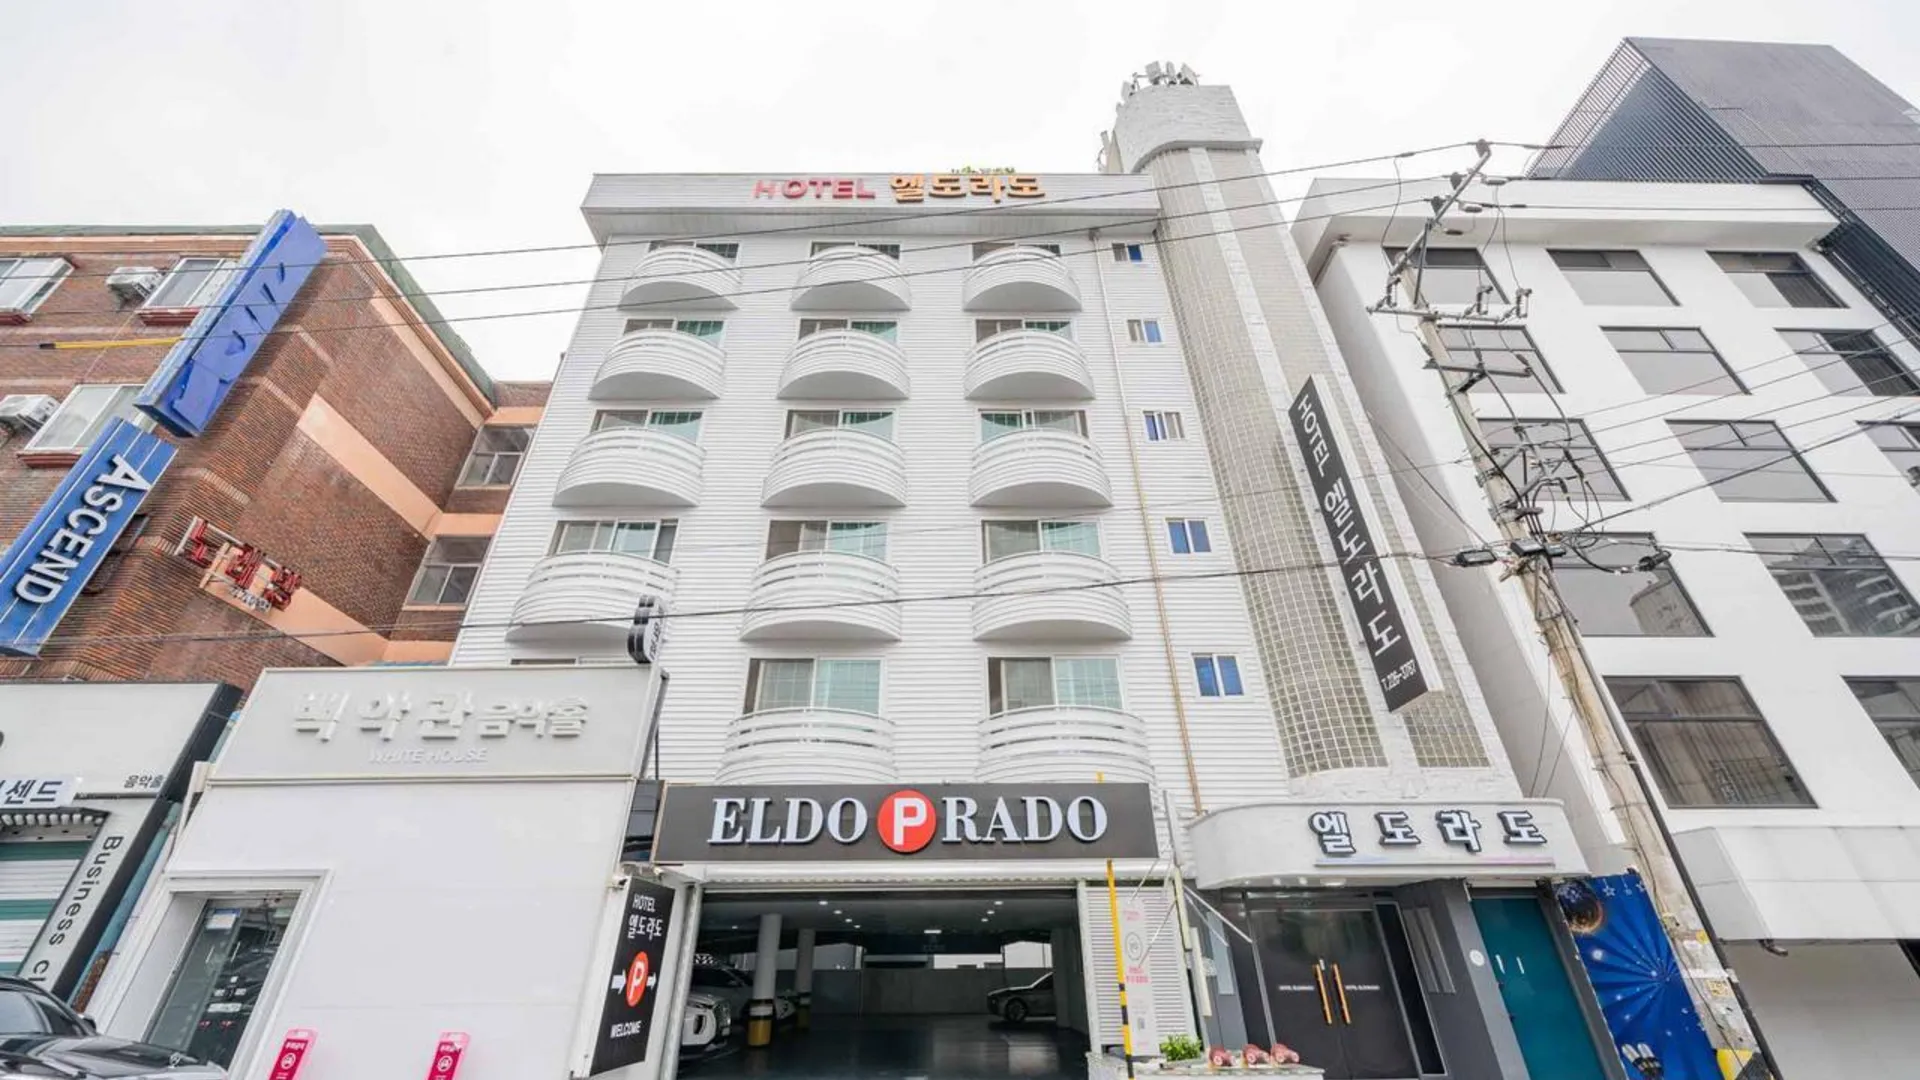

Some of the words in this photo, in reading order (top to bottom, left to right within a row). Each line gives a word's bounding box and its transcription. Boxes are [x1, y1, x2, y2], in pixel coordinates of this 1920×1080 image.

[753, 178, 876, 200] HOTEL
[889, 174, 1046, 204] 엘도라도
[16, 453, 153, 604] ASCEND
[1297, 393, 1331, 478] HOTEL
[1323, 476, 1402, 657] 엘도라도
[292, 689, 474, 743] 백악관
[0, 779, 62, 804] 센드
[706, 796, 869, 845] ELDO
[941, 795, 1109, 845] RADO
[49, 835, 124, 946] Business
[632, 893, 656, 913] HOTEL
[627, 914, 664, 941] 엘도라도
[610, 1020, 642, 1039] WELCOME
